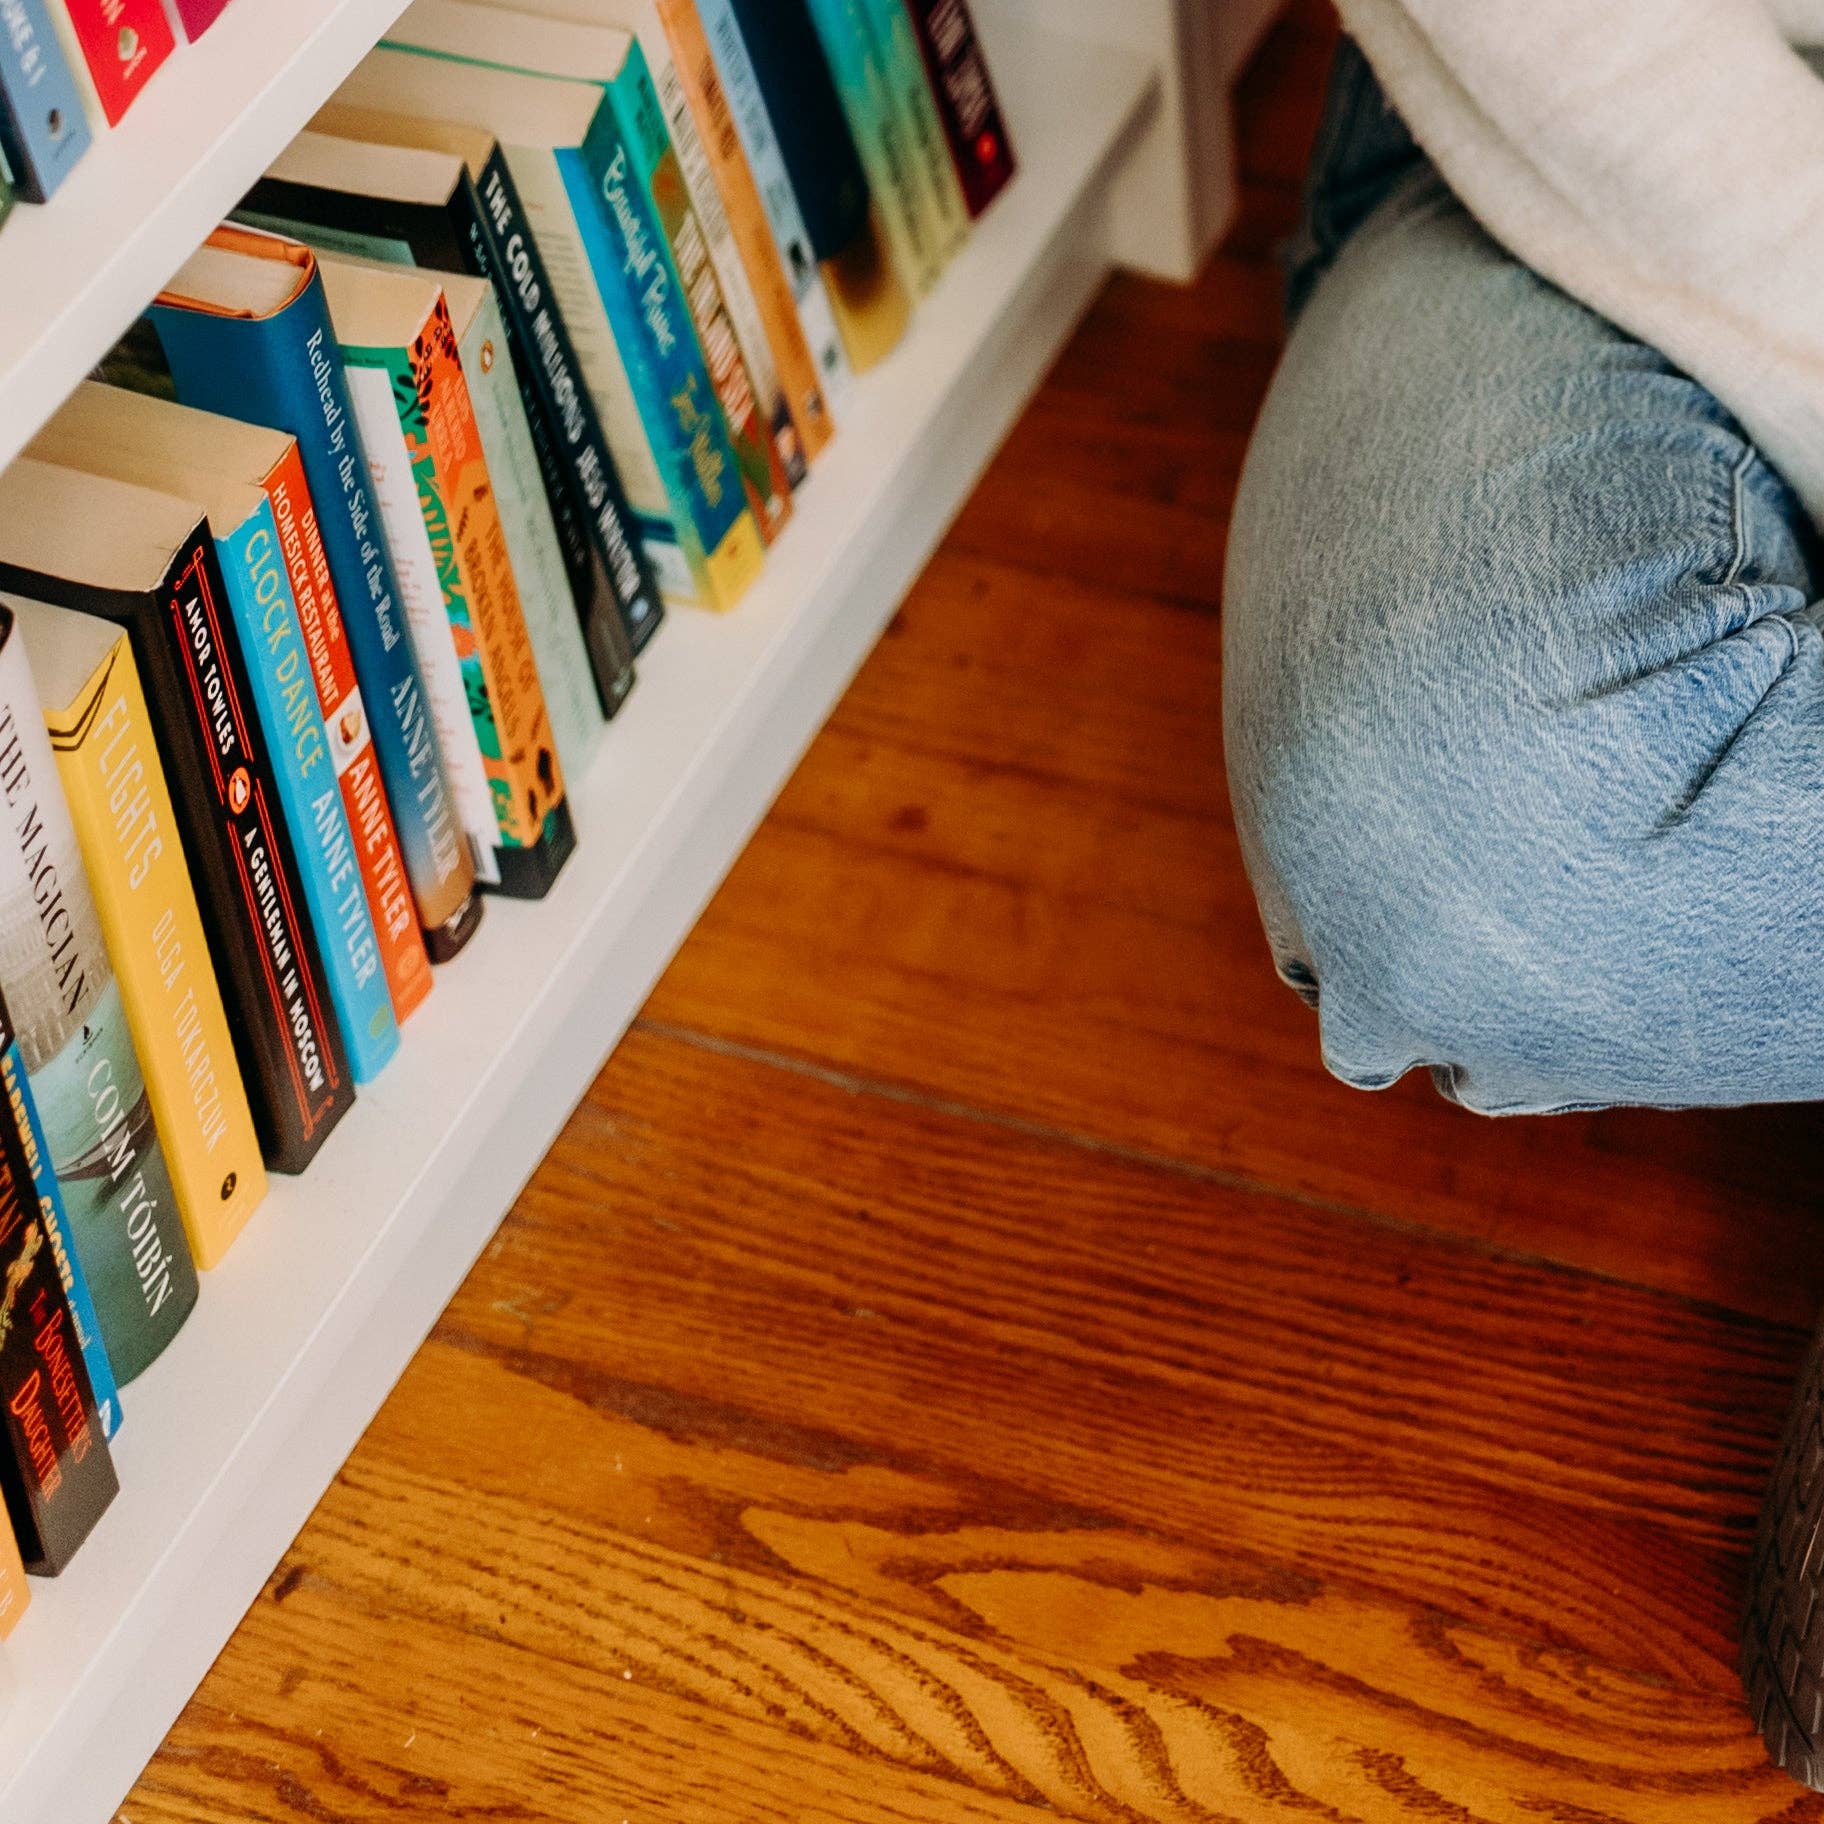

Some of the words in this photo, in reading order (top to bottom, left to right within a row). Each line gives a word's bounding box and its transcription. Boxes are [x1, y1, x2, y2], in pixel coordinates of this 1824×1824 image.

[482, 170, 512, 232] THE
[505, 233, 542, 313] COLD
[530, 305, 588, 445] MILLIONS
[304, 327, 342, 423] Redhead
[329, 417, 346, 457] by
[337, 453, 357, 494] the
[300, 506, 330, 590] DINNER
[346, 490, 368, 538] Side
[359, 532, 376, 565] of
[271, 480, 310, 600] HOMESICK
[297, 594, 341, 708] RESTAURANT
[319, 586, 334, 613] at
[325, 609, 343, 643] the
[364, 565, 386, 604] the
[374, 604, 401, 654] Road
[183, 596, 216, 670] AMOR
[203, 661, 237, 758] TOWLES
[388, 673, 424, 781] ANNE
[0, 700, 33, 811] THE
[243, 527, 292, 655] CLOCK
[274, 651, 326, 780] DANCE
[310, 788, 351, 895] ANNE
[333, 886, 379, 993] TYLER
[243, 826, 257, 850] A
[347, 751, 382, 850] ANNE
[369, 841, 412, 943] TYLER
[413, 774, 463, 886] TYLER
[15, 811, 93, 1018] MAGICIAN
[91, 693, 163, 892] FLIGHTS
[152, 907, 175, 995] OLGA
[171, 988, 229, 1156] TOKARCZUK
[244, 843, 291, 971] GENTLEMAN
[280, 966, 298, 1005] IN
[288, 1003, 325, 1095] MOSCOW
[84, 1055, 138, 1184] COLM
[118, 1168, 177, 1320] TÓIBÍN
[10, 1367, 64, 1504] DAUGHTER
[33, 1306, 94, 1467] BONESETTER'S
